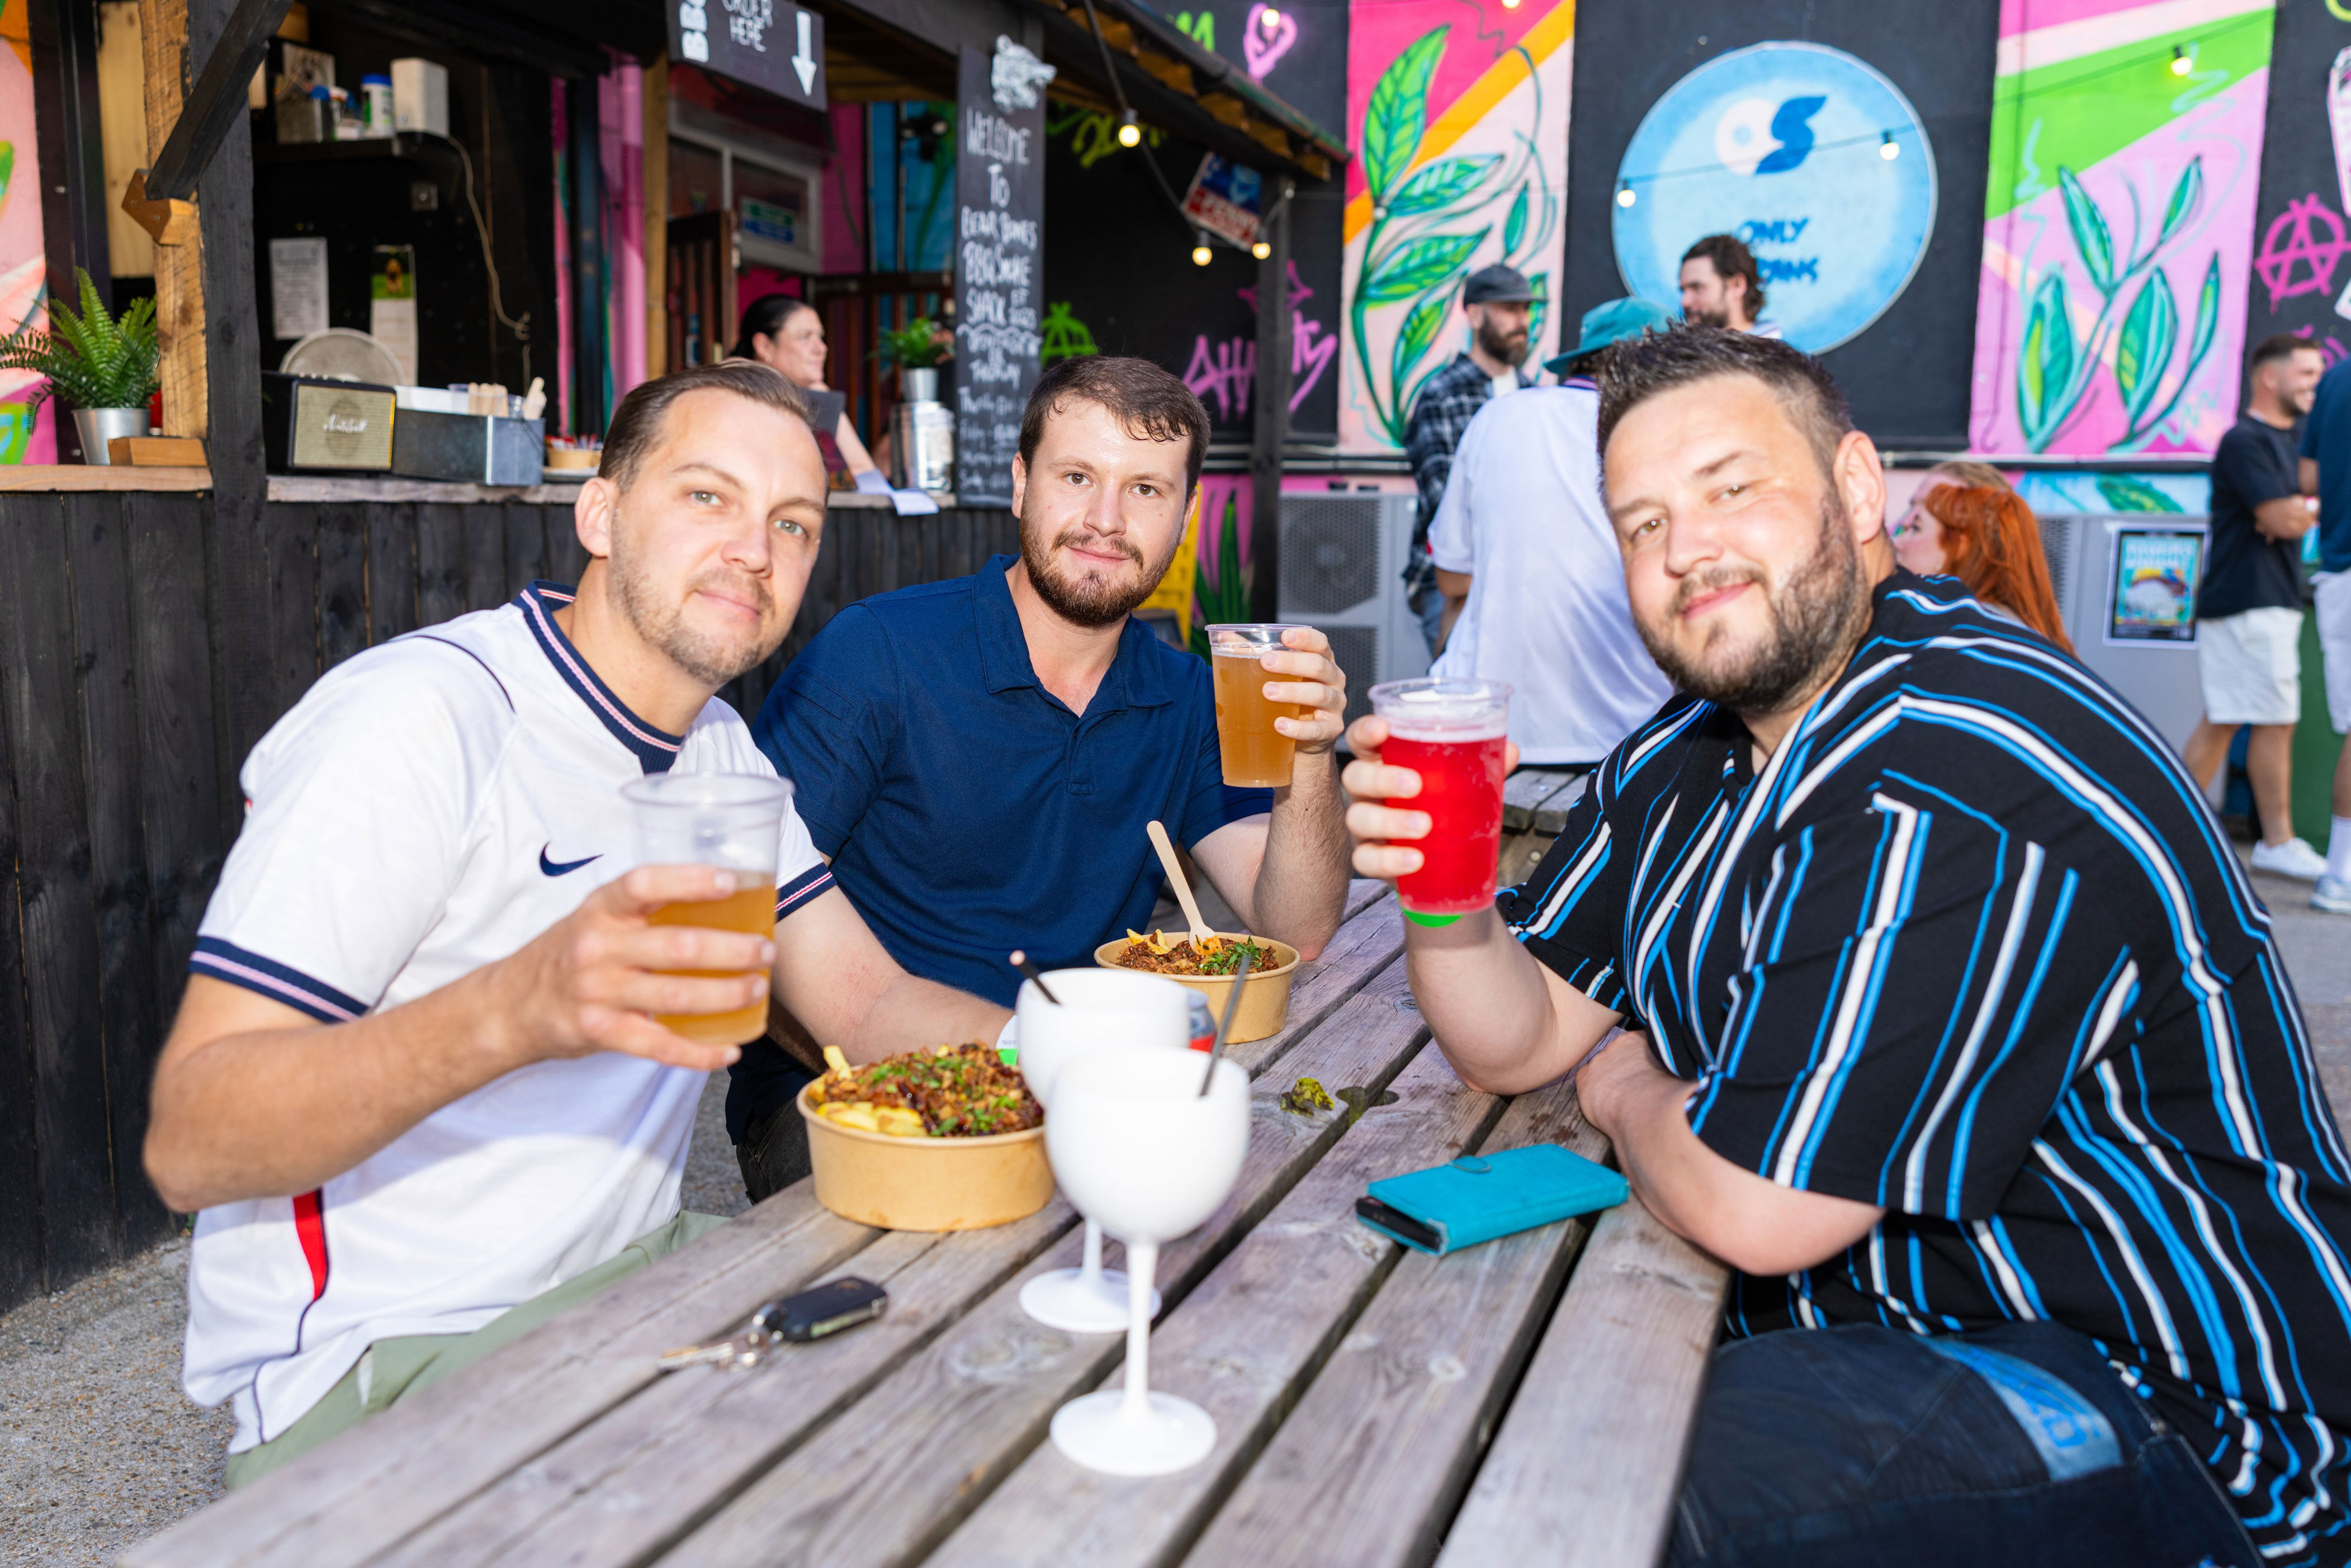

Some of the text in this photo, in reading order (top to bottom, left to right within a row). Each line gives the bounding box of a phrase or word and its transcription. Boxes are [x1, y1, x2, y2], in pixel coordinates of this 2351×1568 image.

[729, 15, 767, 53] HERE
[966, 106, 1031, 165] WELCOME
[961, 205, 1001, 242] BEAR
[1734, 216, 1810, 246] ONLY
[965, 286, 1007, 326] SHACK
